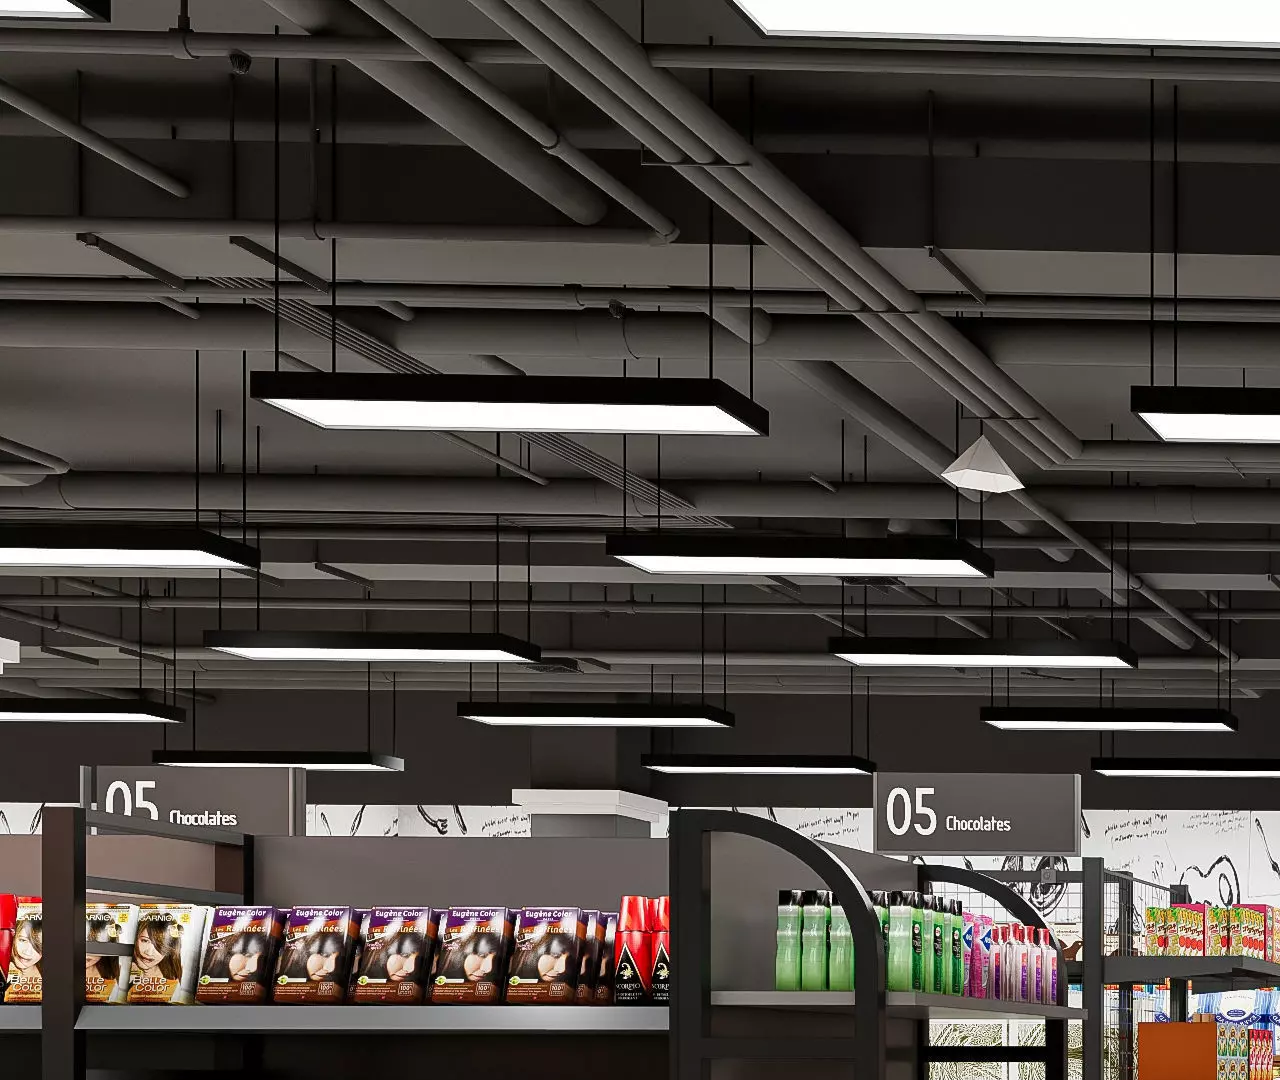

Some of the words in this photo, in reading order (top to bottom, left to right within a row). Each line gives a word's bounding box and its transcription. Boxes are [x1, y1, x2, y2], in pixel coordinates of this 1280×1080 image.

[886, 787, 938, 836] 05
[945, 815, 1012, 832] Chocolates
[219, 909, 246, 918] Eugène
[247, 909, 267, 917] Color
[296, 909, 323, 918] Eugène
[324, 909, 343, 917] Color
[375, 910, 403, 919] Eugène
[452, 910, 479, 919] Eugène
[479, 910, 500, 918] Color
[525, 910, 553, 919] Eugène
[553, 910, 573, 918] Color
[11, 983, 42, 992] Colo
